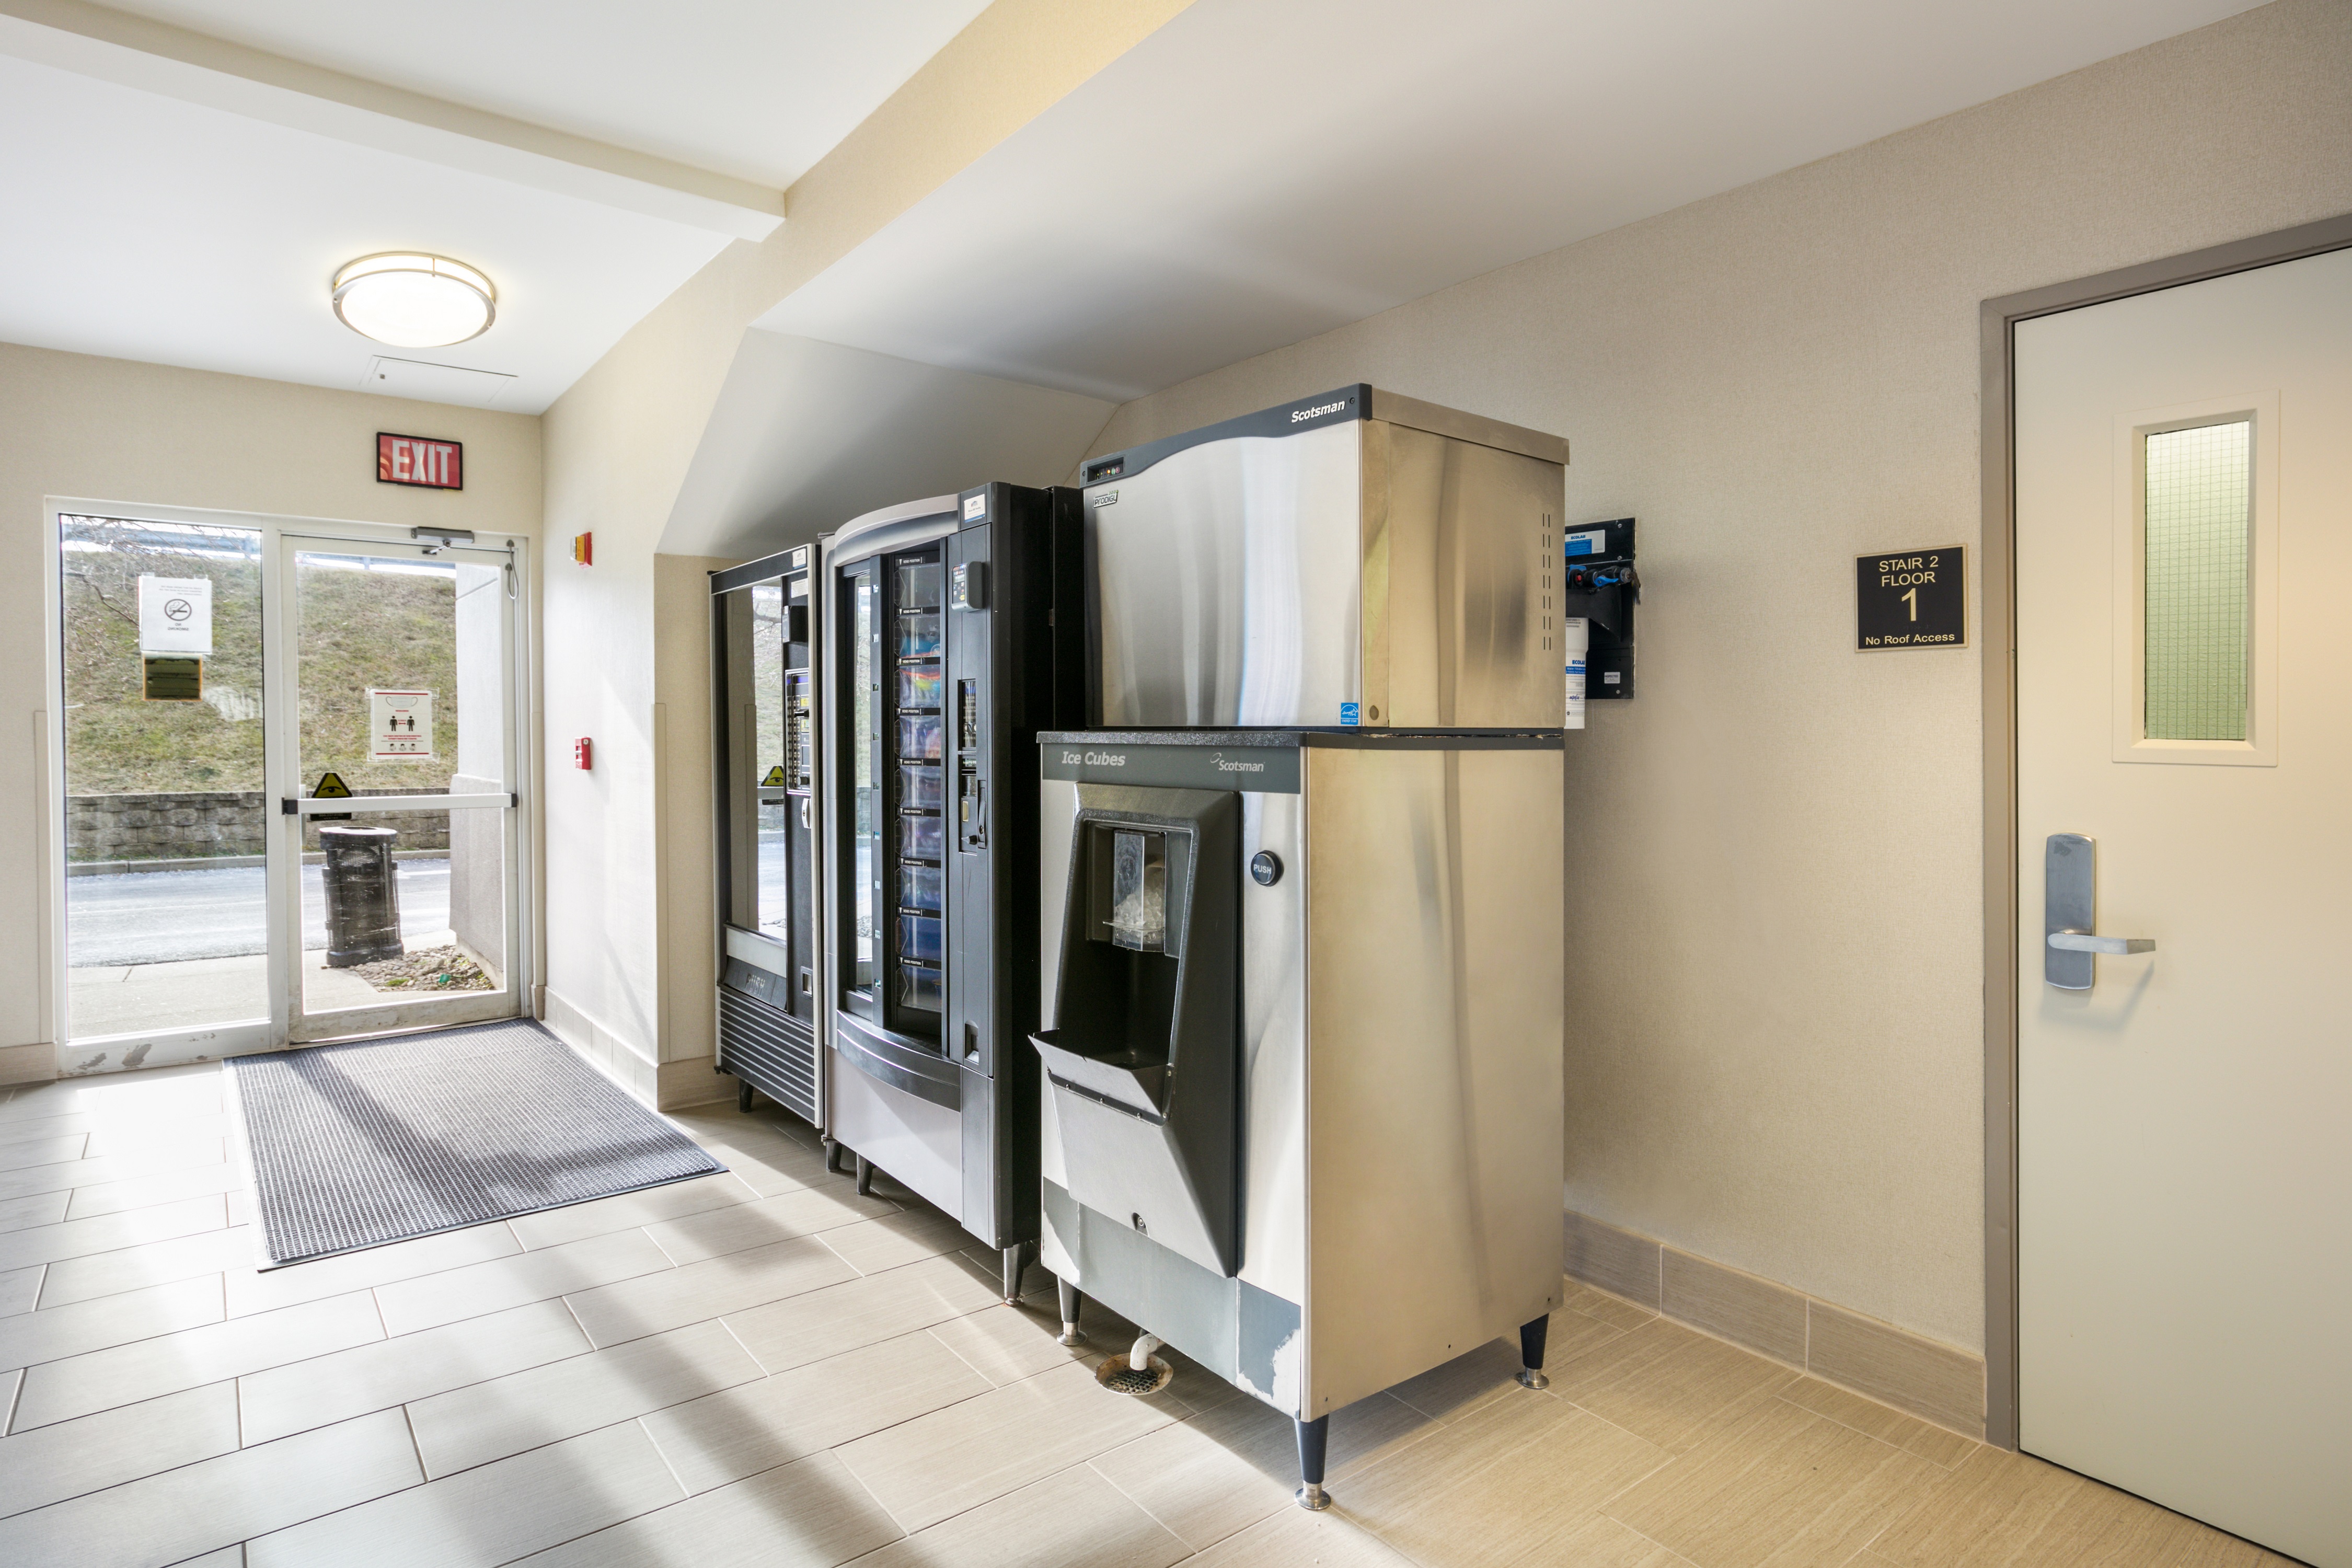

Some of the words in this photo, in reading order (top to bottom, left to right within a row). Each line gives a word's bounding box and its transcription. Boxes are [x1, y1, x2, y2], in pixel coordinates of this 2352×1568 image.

[1292, 400, 1345, 422] Scotsman
[393, 440, 452, 484] EXIT
[1879, 557, 1923, 572] STAIR
[1930, 556, 1939, 568] 2
[1882, 571, 1936, 587] FLOOR
[1901, 587, 1917, 621] 1
[1866, 637, 1880, 645] No
[1885, 635, 1910, 644] Roof
[1913, 633, 1955, 643] Access
[1062, 751, 1081, 764] Ice
[1085, 752, 1126, 766] Cubes
[1219, 760, 1264, 771] Scotsman
[1253, 864, 1272, 874] PUSH
[745, 973, 765, 997] PUSH
